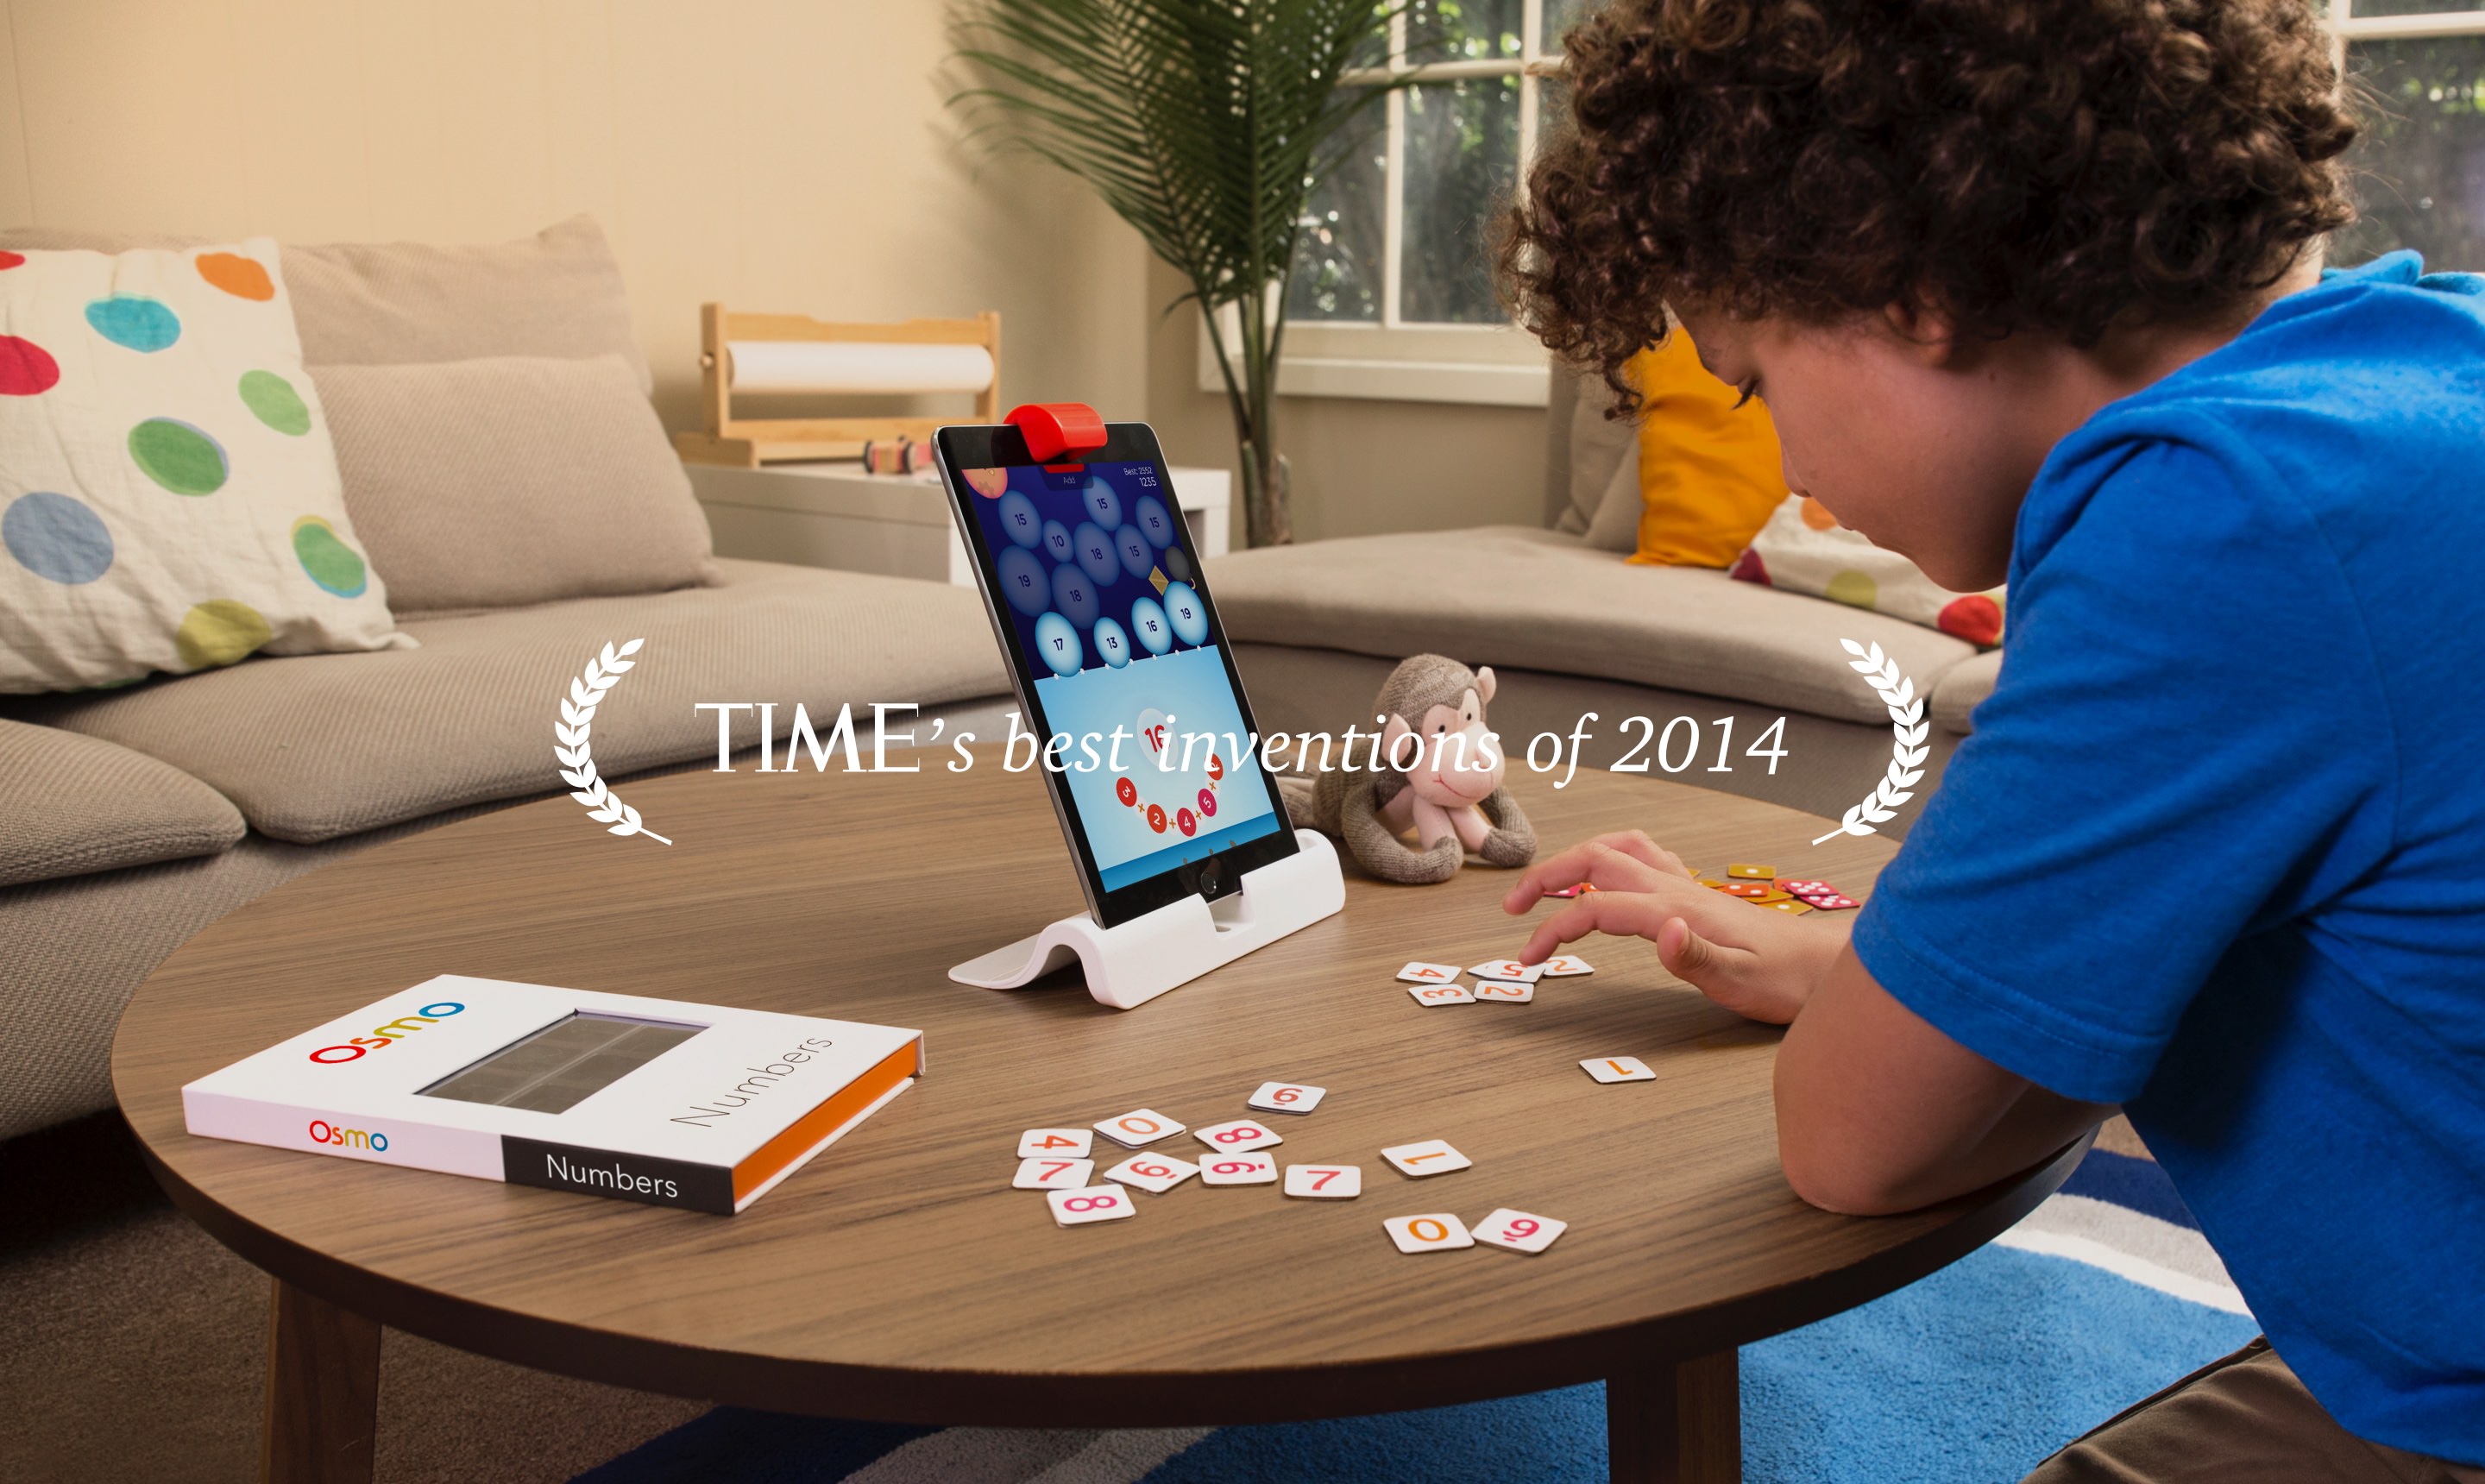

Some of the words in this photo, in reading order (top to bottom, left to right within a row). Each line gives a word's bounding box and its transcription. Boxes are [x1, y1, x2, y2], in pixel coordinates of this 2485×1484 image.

[1063, 476, 1076, 485] Add
[1139, 476, 1157, 487] 1235
[1097, 498, 1108, 510] 15
[1015, 513, 1027, 525] 15
[1149, 517, 1160, 529] 15
[1052, 535, 1065, 548] 10
[1091, 548, 1103, 560] 18
[1129, 545, 1140, 557] 15
[1018, 575, 1031, 588] 19
[1070, 589, 1082, 603] 18
[1180, 607, 1192, 619] 19
[1146, 620, 1157, 632] 16
[1054, 638, 1063, 651] 17
[1106, 637, 1117, 649] 13
[1122, 786, 1131, 798] 3
[1204, 797, 1211, 808] 5
[1153, 813, 1161, 826] 2
[1184, 816, 1192, 828] 4
[1409, 968, 1445, 978] 4
[1500, 963, 1529, 978] 5
[1421, 988, 1463, 999] 3
[1484, 986, 1525, 997] 2
[309, 1003, 465, 1064] Osmo
[1606, 1060, 1633, 1075] 1
[670, 1038, 833, 1128] Numbers
[1118, 1117, 1161, 1135] 0
[309, 1120, 388, 1152] Osmo
[1031, 1135, 1079, 1149] 4
[1214, 1128, 1262, 1143] 8
[1402, 1152, 1447, 1166] 1
[546, 1154, 678, 1198] Numbers
[1038, 1161, 1074, 1182] 7
[1306, 1170, 1342, 1191] 7
[1063, 1196, 1117, 1212] 8
[1407, 1218, 1449, 1242] 0
